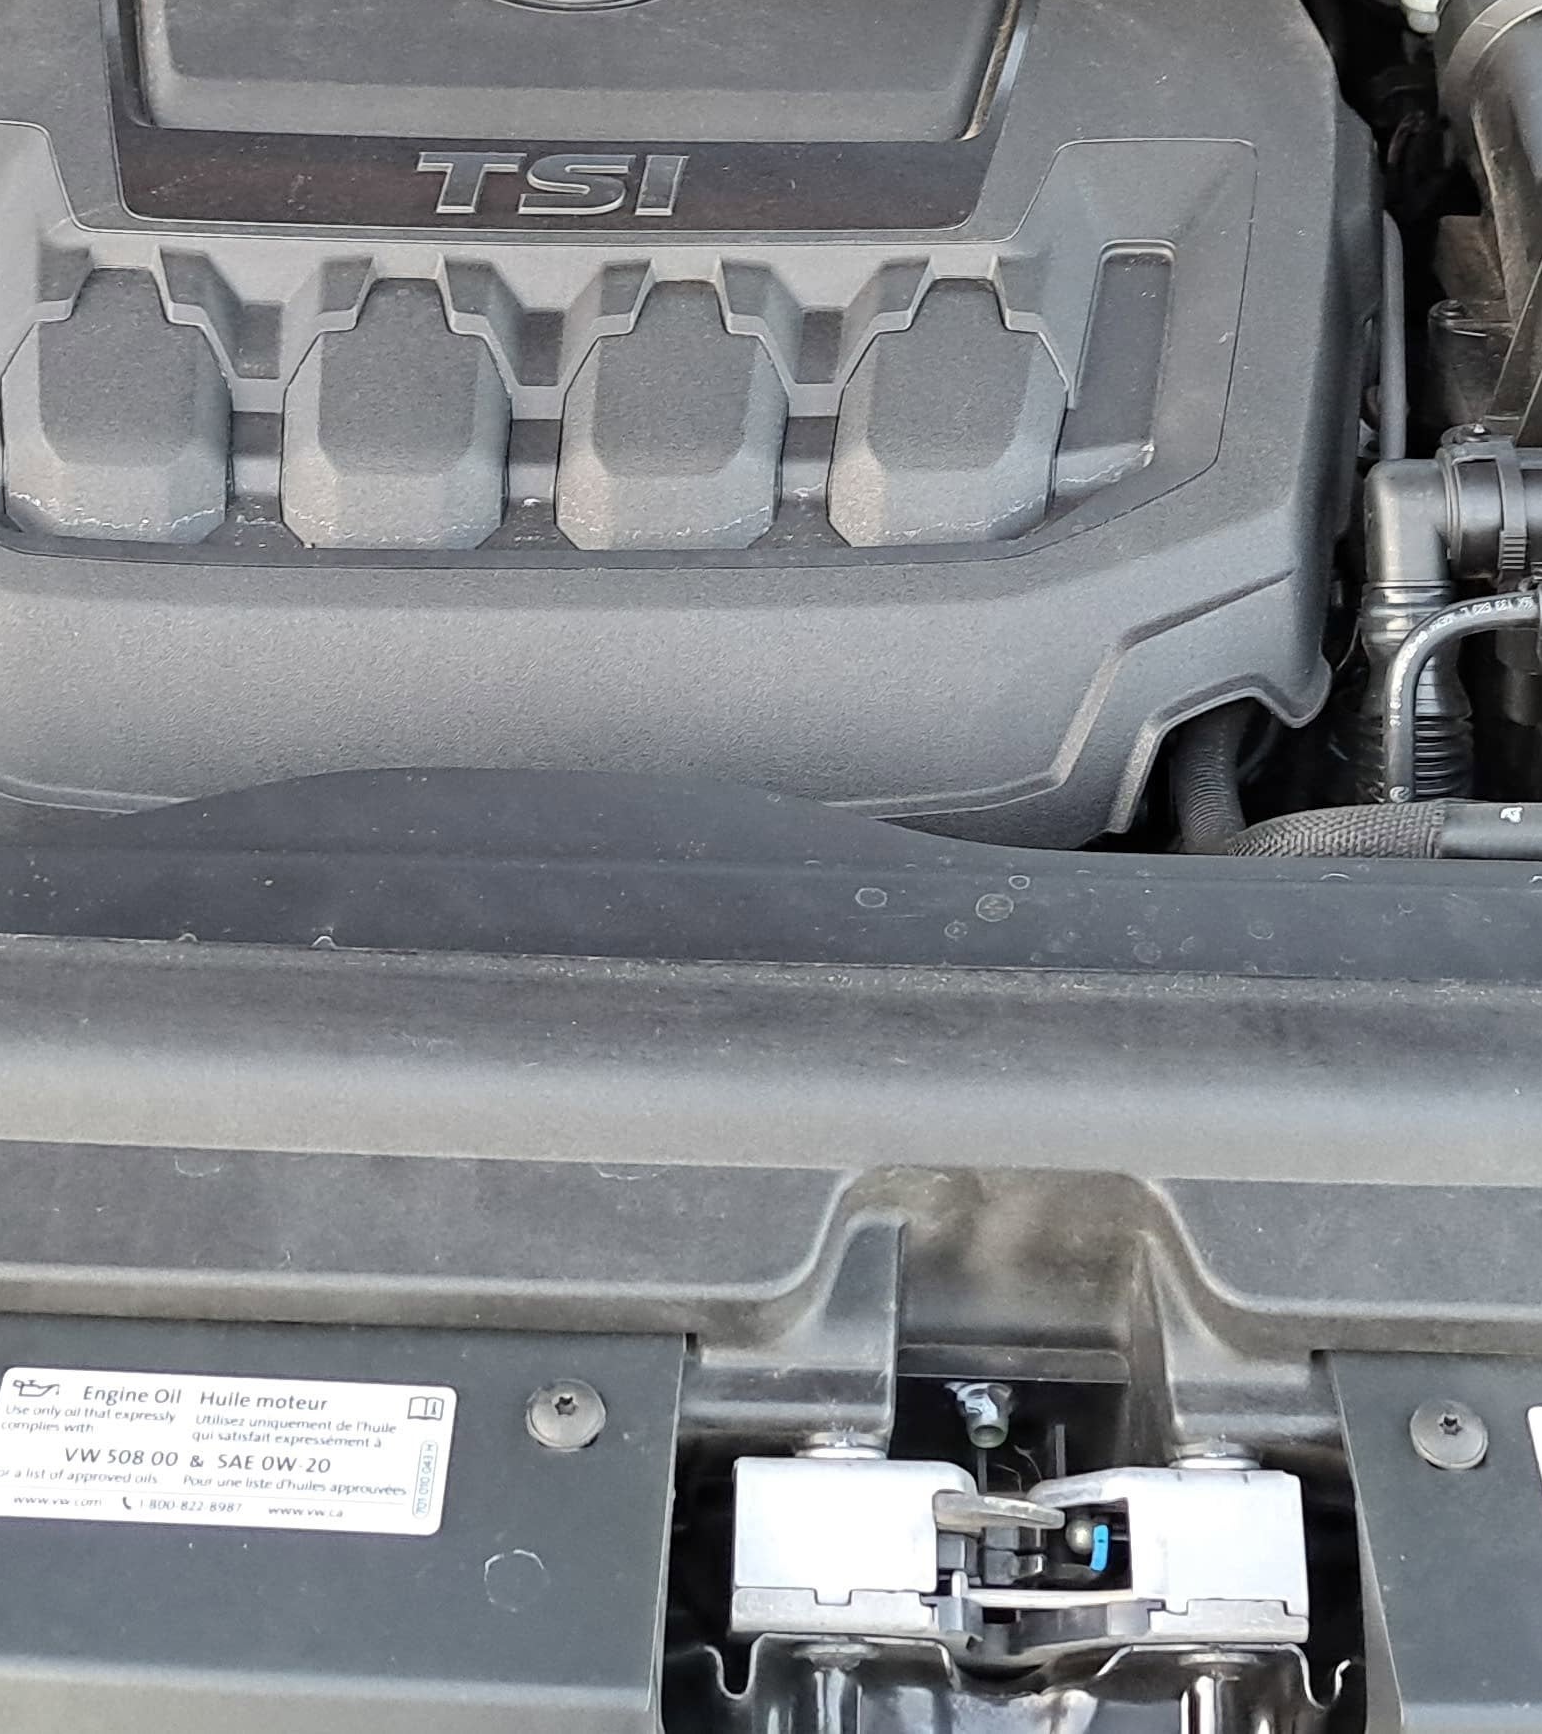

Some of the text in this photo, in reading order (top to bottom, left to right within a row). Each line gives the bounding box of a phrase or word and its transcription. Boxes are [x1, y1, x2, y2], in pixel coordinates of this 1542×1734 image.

[416, 151, 689, 217] TSI
[83, 1386, 182, 1406] Engine Oil
[200, 1391, 328, 1410] Huile moteur
[6, 1405, 175, 1424] Use only oil that expressly
[196, 1414, 397, 1434] Utilisez uniquement de l'huile
[1, 1421, 94, 1434] complies with
[192, 1432, 213, 1442] qui
[218, 1431, 270, 1442] satisfait
[374, 1438, 382, 1448] à
[65, 1448, 101, 1463] VW
[107, 1449, 145, 1465] 508
[151, 1451, 178, 1466] 00
[189, 1455, 204, 1468] &
[218, 1454, 254, 1470] SAE
[14, 1470, 22, 1478] a
[26, 1468, 45, 1479] list
[50, 1469, 64, 1480] of
[67, 1473, 132, 1484] approved
[135, 1474, 157, 1484] oils
[183, 1474, 212, 1486] Pour
[217, 1479, 242, 1488] une
[246, 1477, 273, 1489] liste
[276, 1479, 326, 1492] d'huiles
